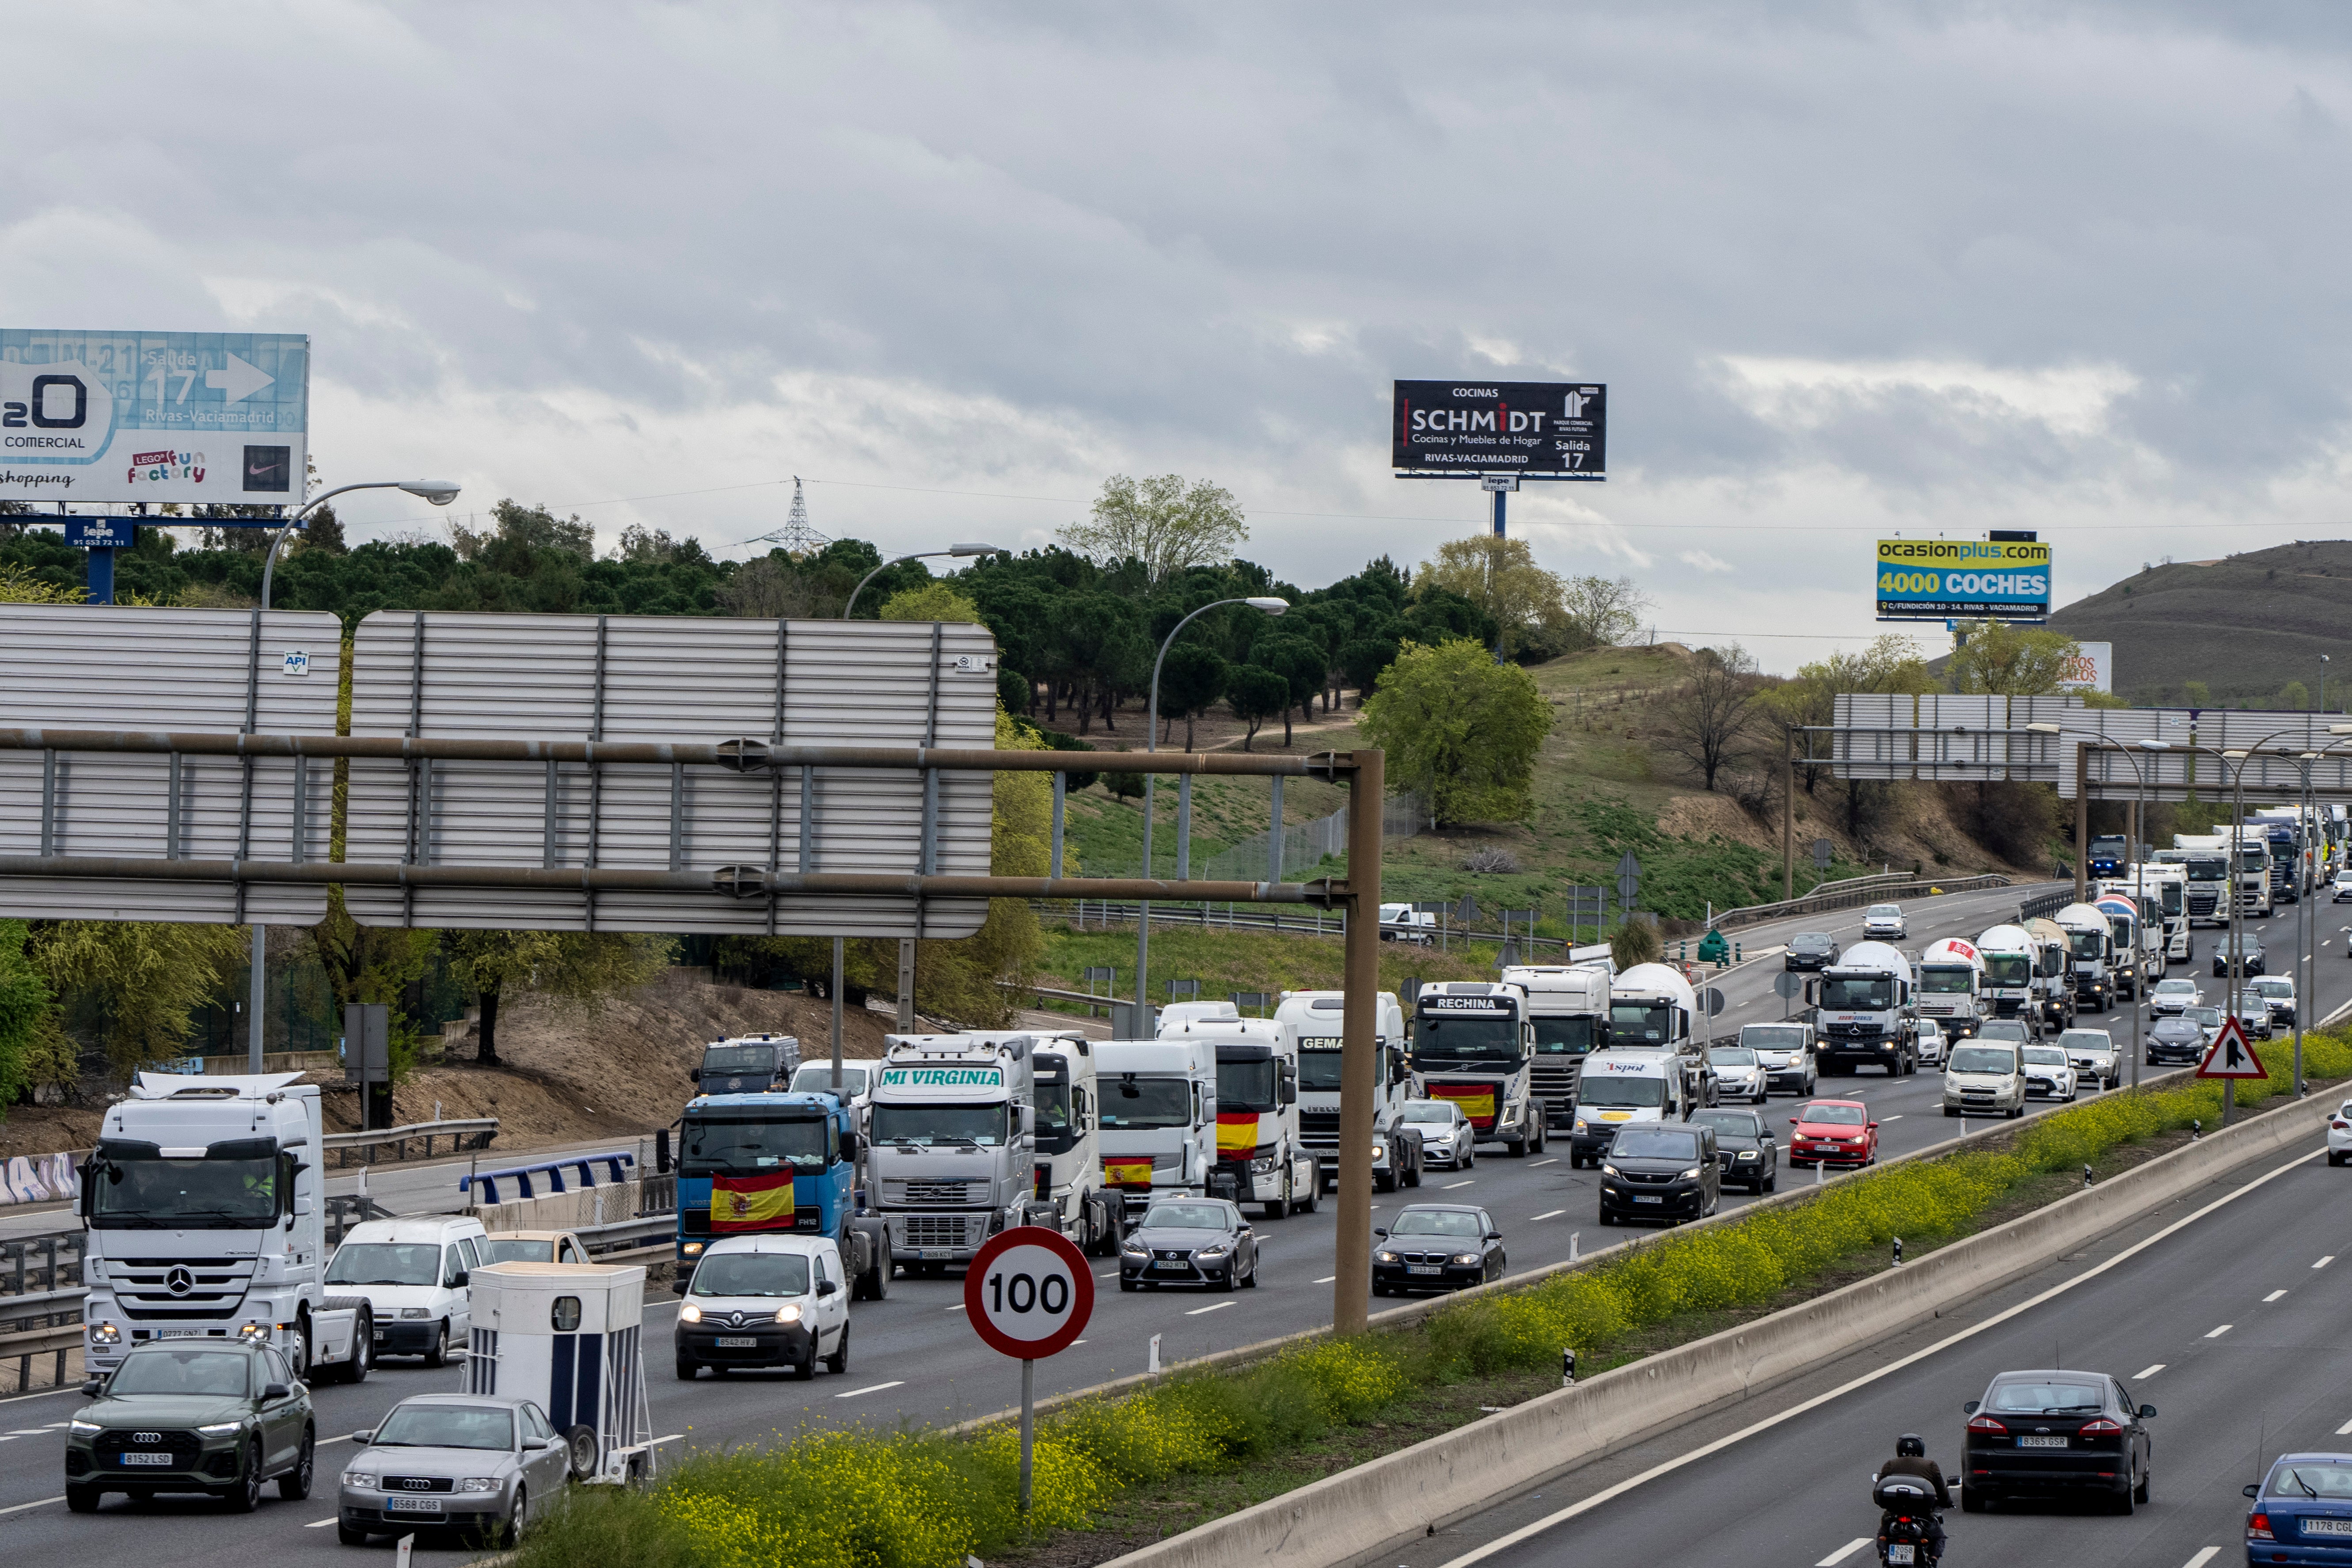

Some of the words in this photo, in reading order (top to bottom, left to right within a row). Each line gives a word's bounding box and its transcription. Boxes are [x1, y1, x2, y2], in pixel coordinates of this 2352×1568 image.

[147, 351, 197, 366] Salida
[147, 369, 197, 405] 17
[1452, 388, 1498, 398] COCINAS
[146, 408, 275, 424] Rivas-Vaciamadrid
[5, 437, 85, 448] COMERCIAL
[1412, 434, 1449, 444] Cocinas
[1451, 437, 1457, 446] y
[1459, 435, 1497, 445] Muebles
[1499, 436, 1512, 445] de
[1513, 436, 1542, 447] Hogar
[1556, 440, 1590, 451] Salida
[167, 449, 206, 466] fun
[1425, 453, 1529, 464] RIVAS-VACIAMADRID
[1562, 453, 1584, 468] 17
[128, 464, 206, 484] factory
[1879, 541, 2048, 561] ocasionplus.com
[1878, 573, 1940, 593] 4000
[1945, 573, 2048, 595] COCHES
[1888, 601, 1935, 610] C/FUNDICIÓN
[285, 656, 307, 666] API
[1437, 999, 1496, 1009] RECHINA
[882, 1070, 908, 1086] MI
[912, 1070, 1000, 1086] VIRGINIA
[988, 1272, 1069, 1315] 100
[2023, 1437, 2046, 1446] 8365
[2048, 1437, 2065, 1446] GSR
[126, 1454, 149, 1463] 8152
[152, 1454, 170, 1463] LSD
[394, 1500, 417, 1509] 6568
[419, 1500, 437, 1510] CGS
[2309, 1521, 2333, 1530] 1178
[2336, 1522, 2352, 1532] CGL
